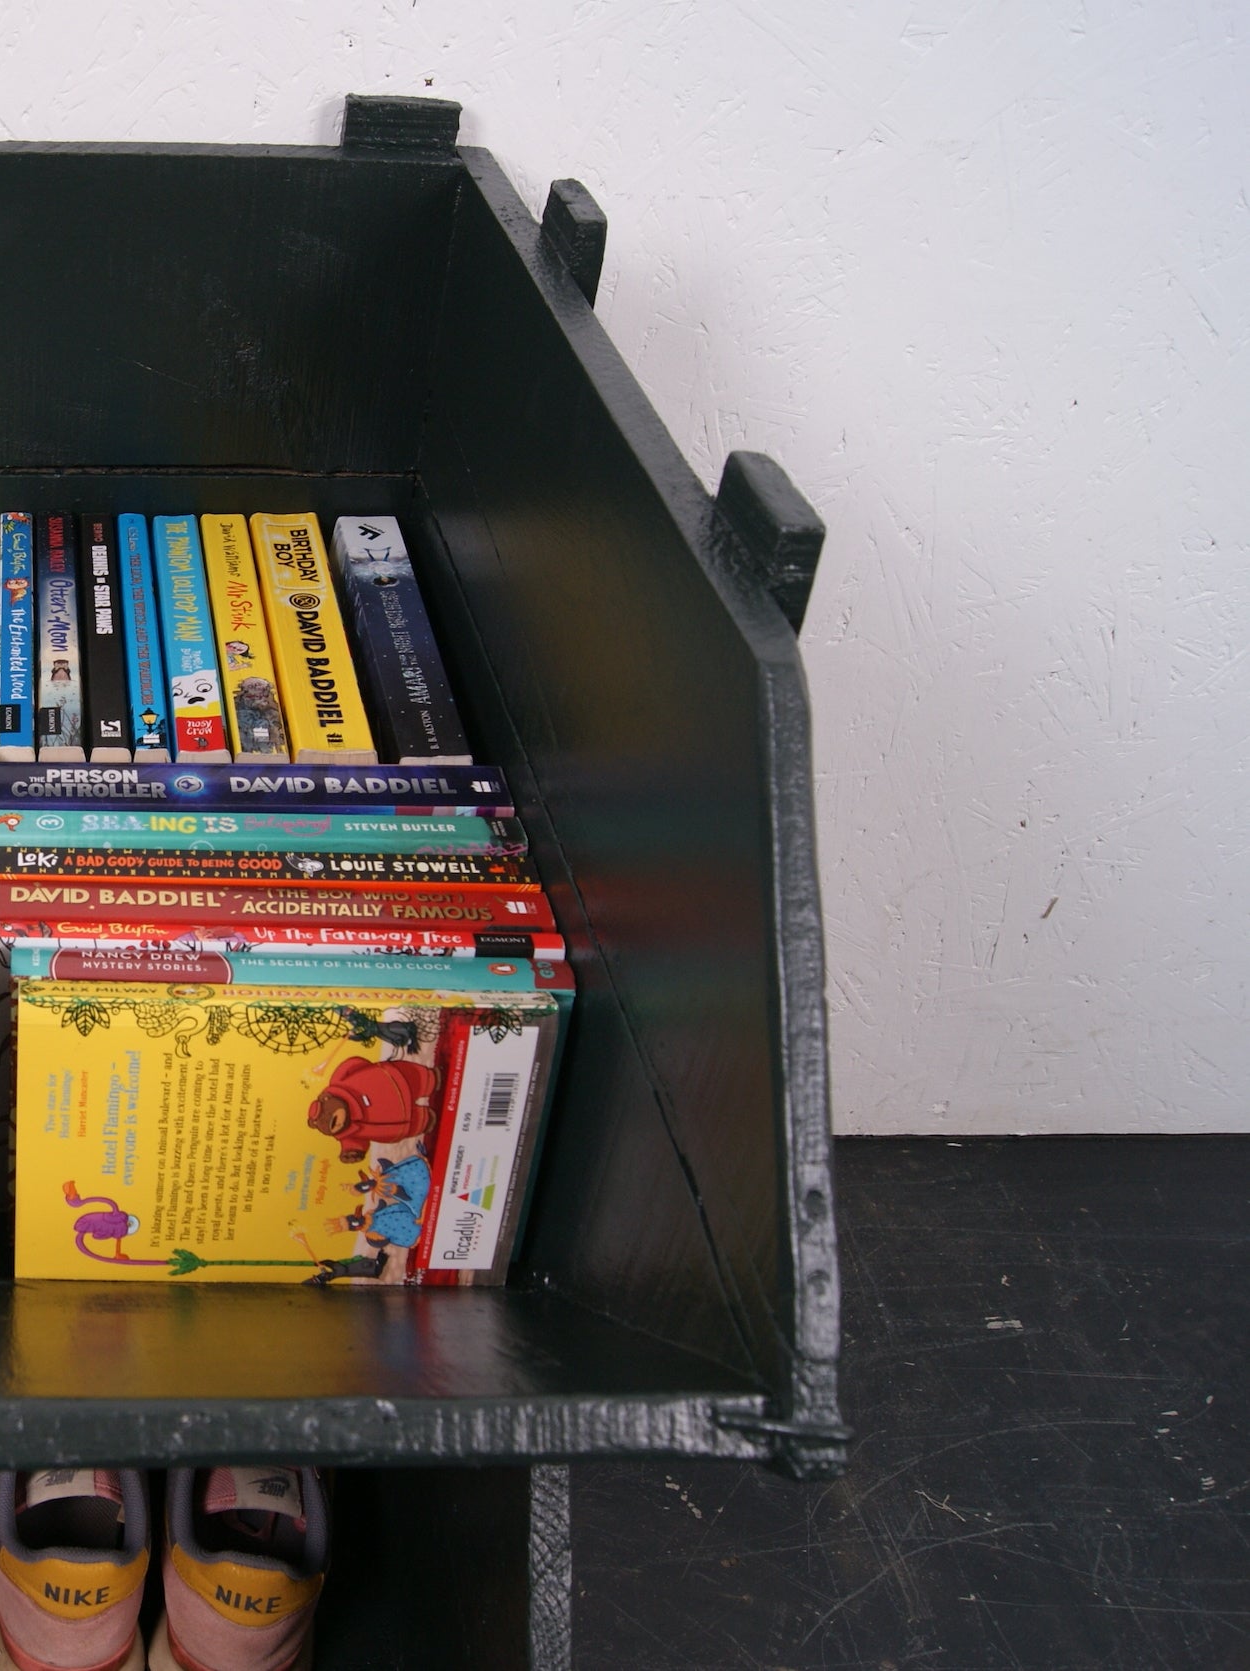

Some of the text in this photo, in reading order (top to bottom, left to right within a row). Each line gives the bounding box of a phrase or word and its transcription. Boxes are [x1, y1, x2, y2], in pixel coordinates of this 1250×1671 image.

[220, 523, 237, 543] David
[273, 543, 295, 569] BOY
[289, 528, 319, 583] BIRTHDAY
[92, 545, 113, 635] DENNIS STAR PAWS
[165, 536, 204, 642] PHANTOM LOLLIPOP MAN!
[227, 580, 256, 631] Mr Stink
[48, 579, 73, 652] Otters' Moon
[9, 608, 28, 700] The Enchanted Wood
[296, 610, 344, 728] DAVID BADDIEL
[186, 719, 212, 728] nosy
[186, 726, 212, 735] crow
[46, 769, 138, 783] PERSON
[11, 781, 167, 799] CONTROLLER
[230, 776, 458, 795] DAVID BADDIEL
[202, 816, 238, 833] IS
[344, 822, 456, 833] STEVEN BUTLER
[76, 856, 282, 869] BAD GUIDE BEING GOOD
[330, 860, 480, 874] LOUIE STOWELL
[10, 886, 221, 908] DAVID BADDIEL
[317, 889, 352, 900] BOY
[362, 890, 409, 902] WHO
[241, 901, 493, 921] ACCIDENTALLY FAMOUS
[56, 922, 169, 939] Enid Blyton
[254, 927, 462, 945] Up The Faraway Tree
[480, 936, 527, 944] EGMONT
[81, 951, 200, 961] NANCY DREW
[270, 959, 452, 971] SECRET OLD CLOCK
[82, 961, 142, 970] MYSTERY
[51, 985, 158, 994] ALEX MILWAY
[222, 988, 448, 1000] HOLIDAY HEATWAVE
[103, 1074, 125, 1175] Hotel Flamingo
[124, 1050, 141, 1186] everyone is welcome!
[443, 1211, 483, 1260] Piccadilly
[43, 1582, 111, 1607] NIKE
[214, 1584, 283, 1615] NIKE
